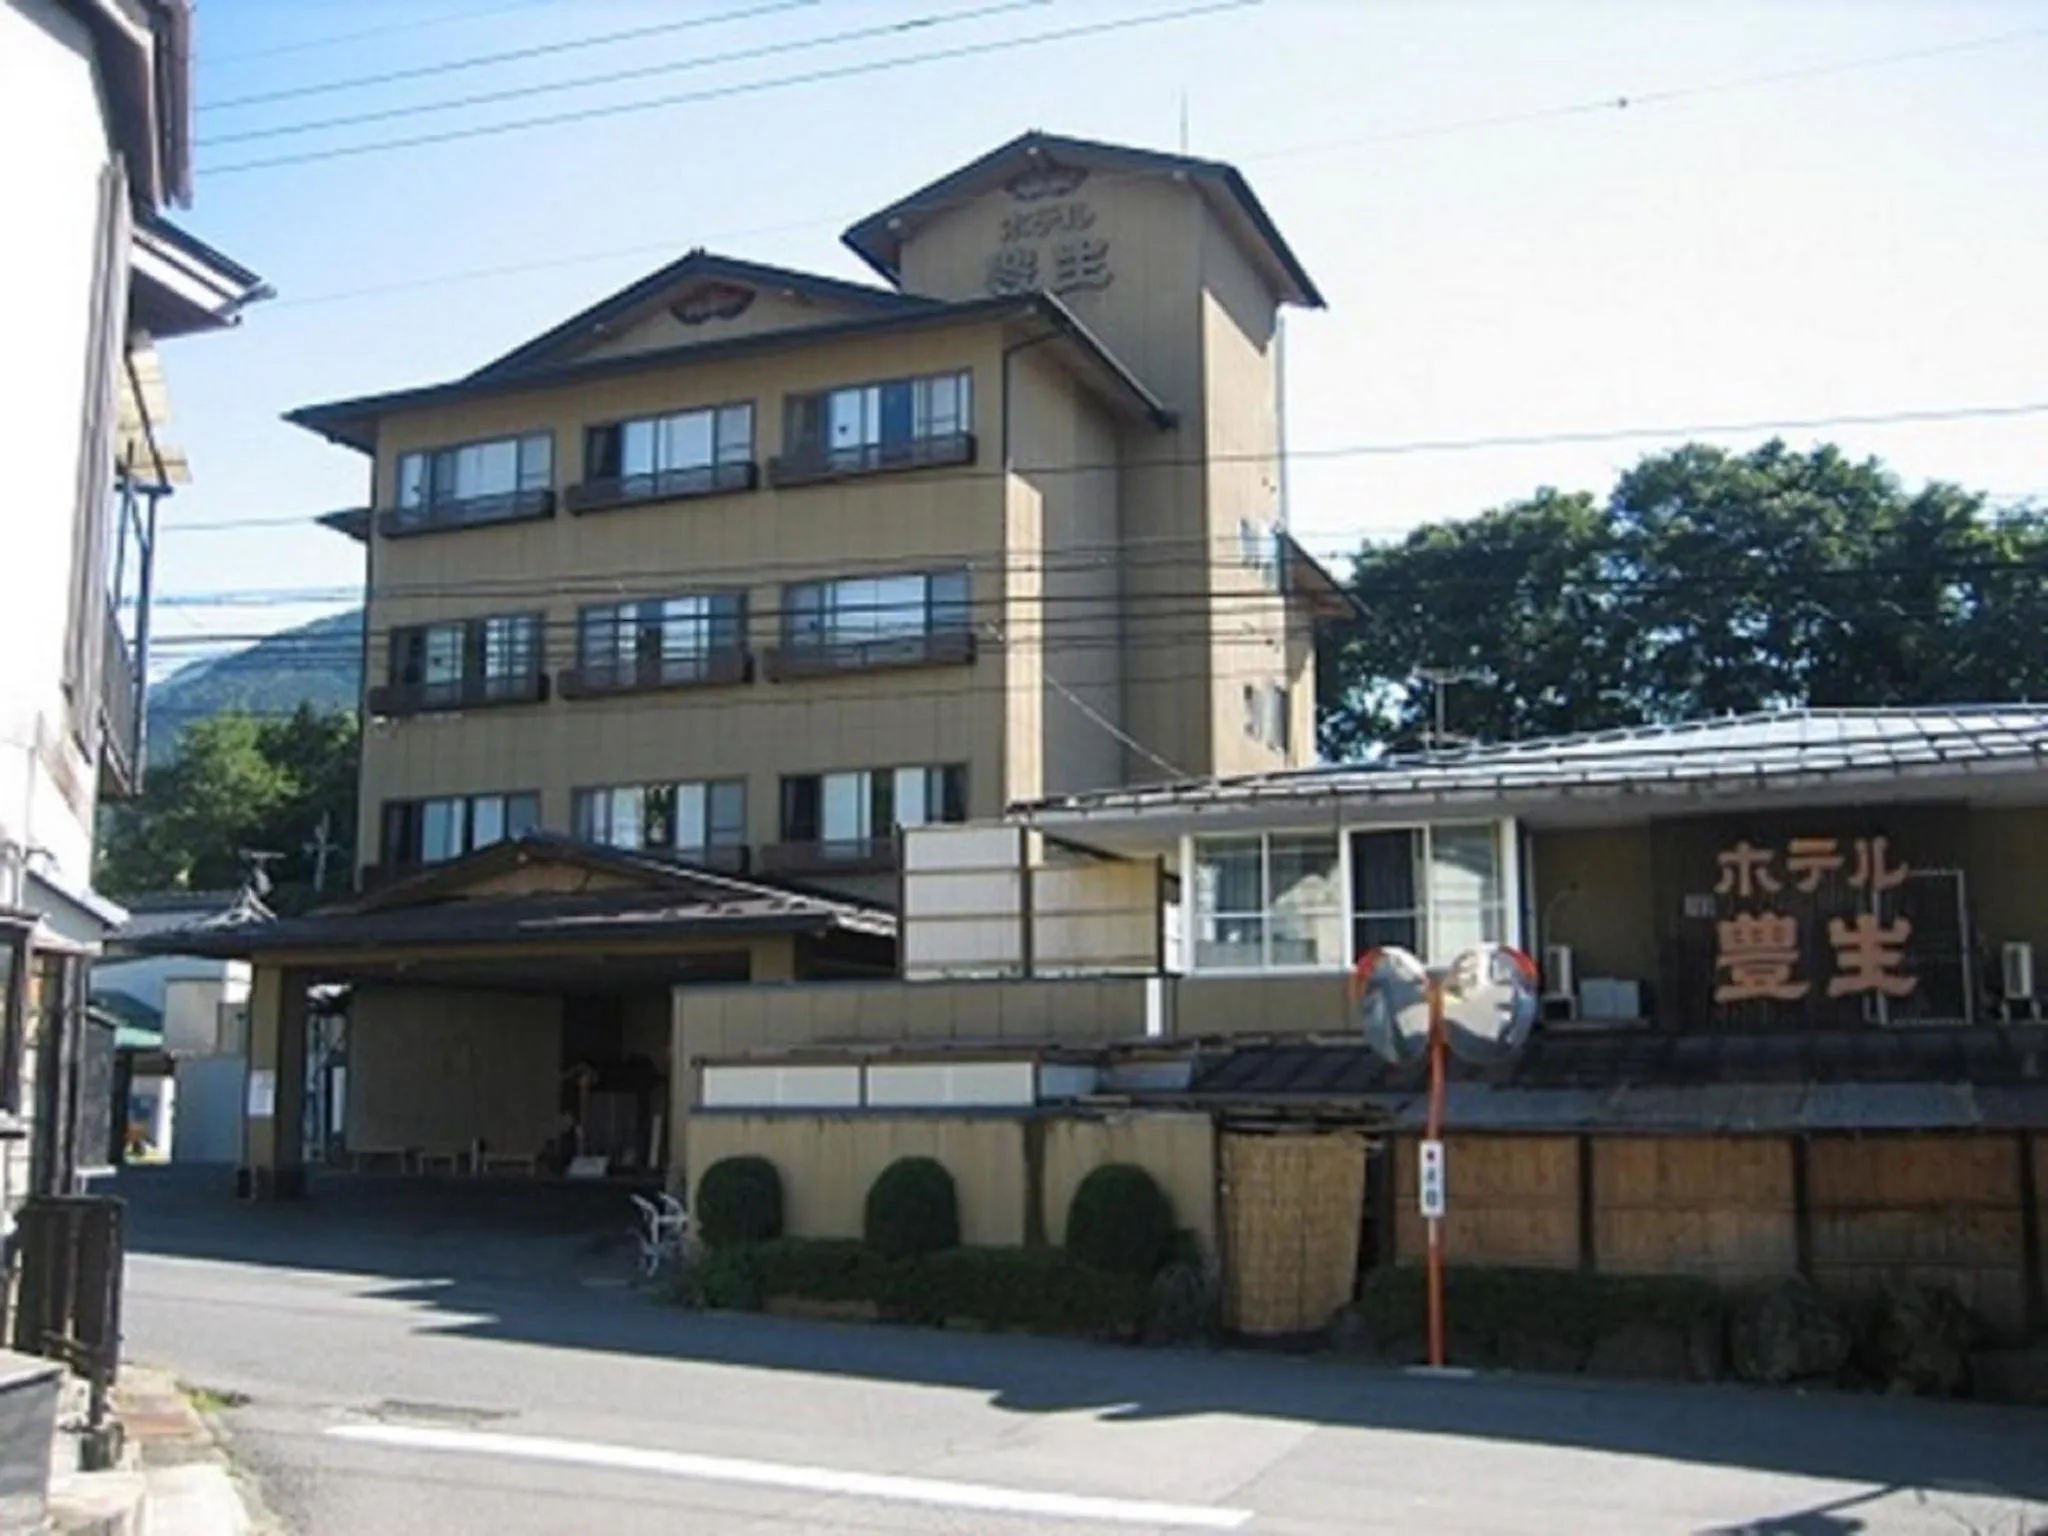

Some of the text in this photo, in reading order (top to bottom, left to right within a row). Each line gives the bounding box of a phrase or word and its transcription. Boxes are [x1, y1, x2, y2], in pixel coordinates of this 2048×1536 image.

[1714, 836, 1908, 897] ホテル
[1714, 911, 1918, 1003] 豊生
